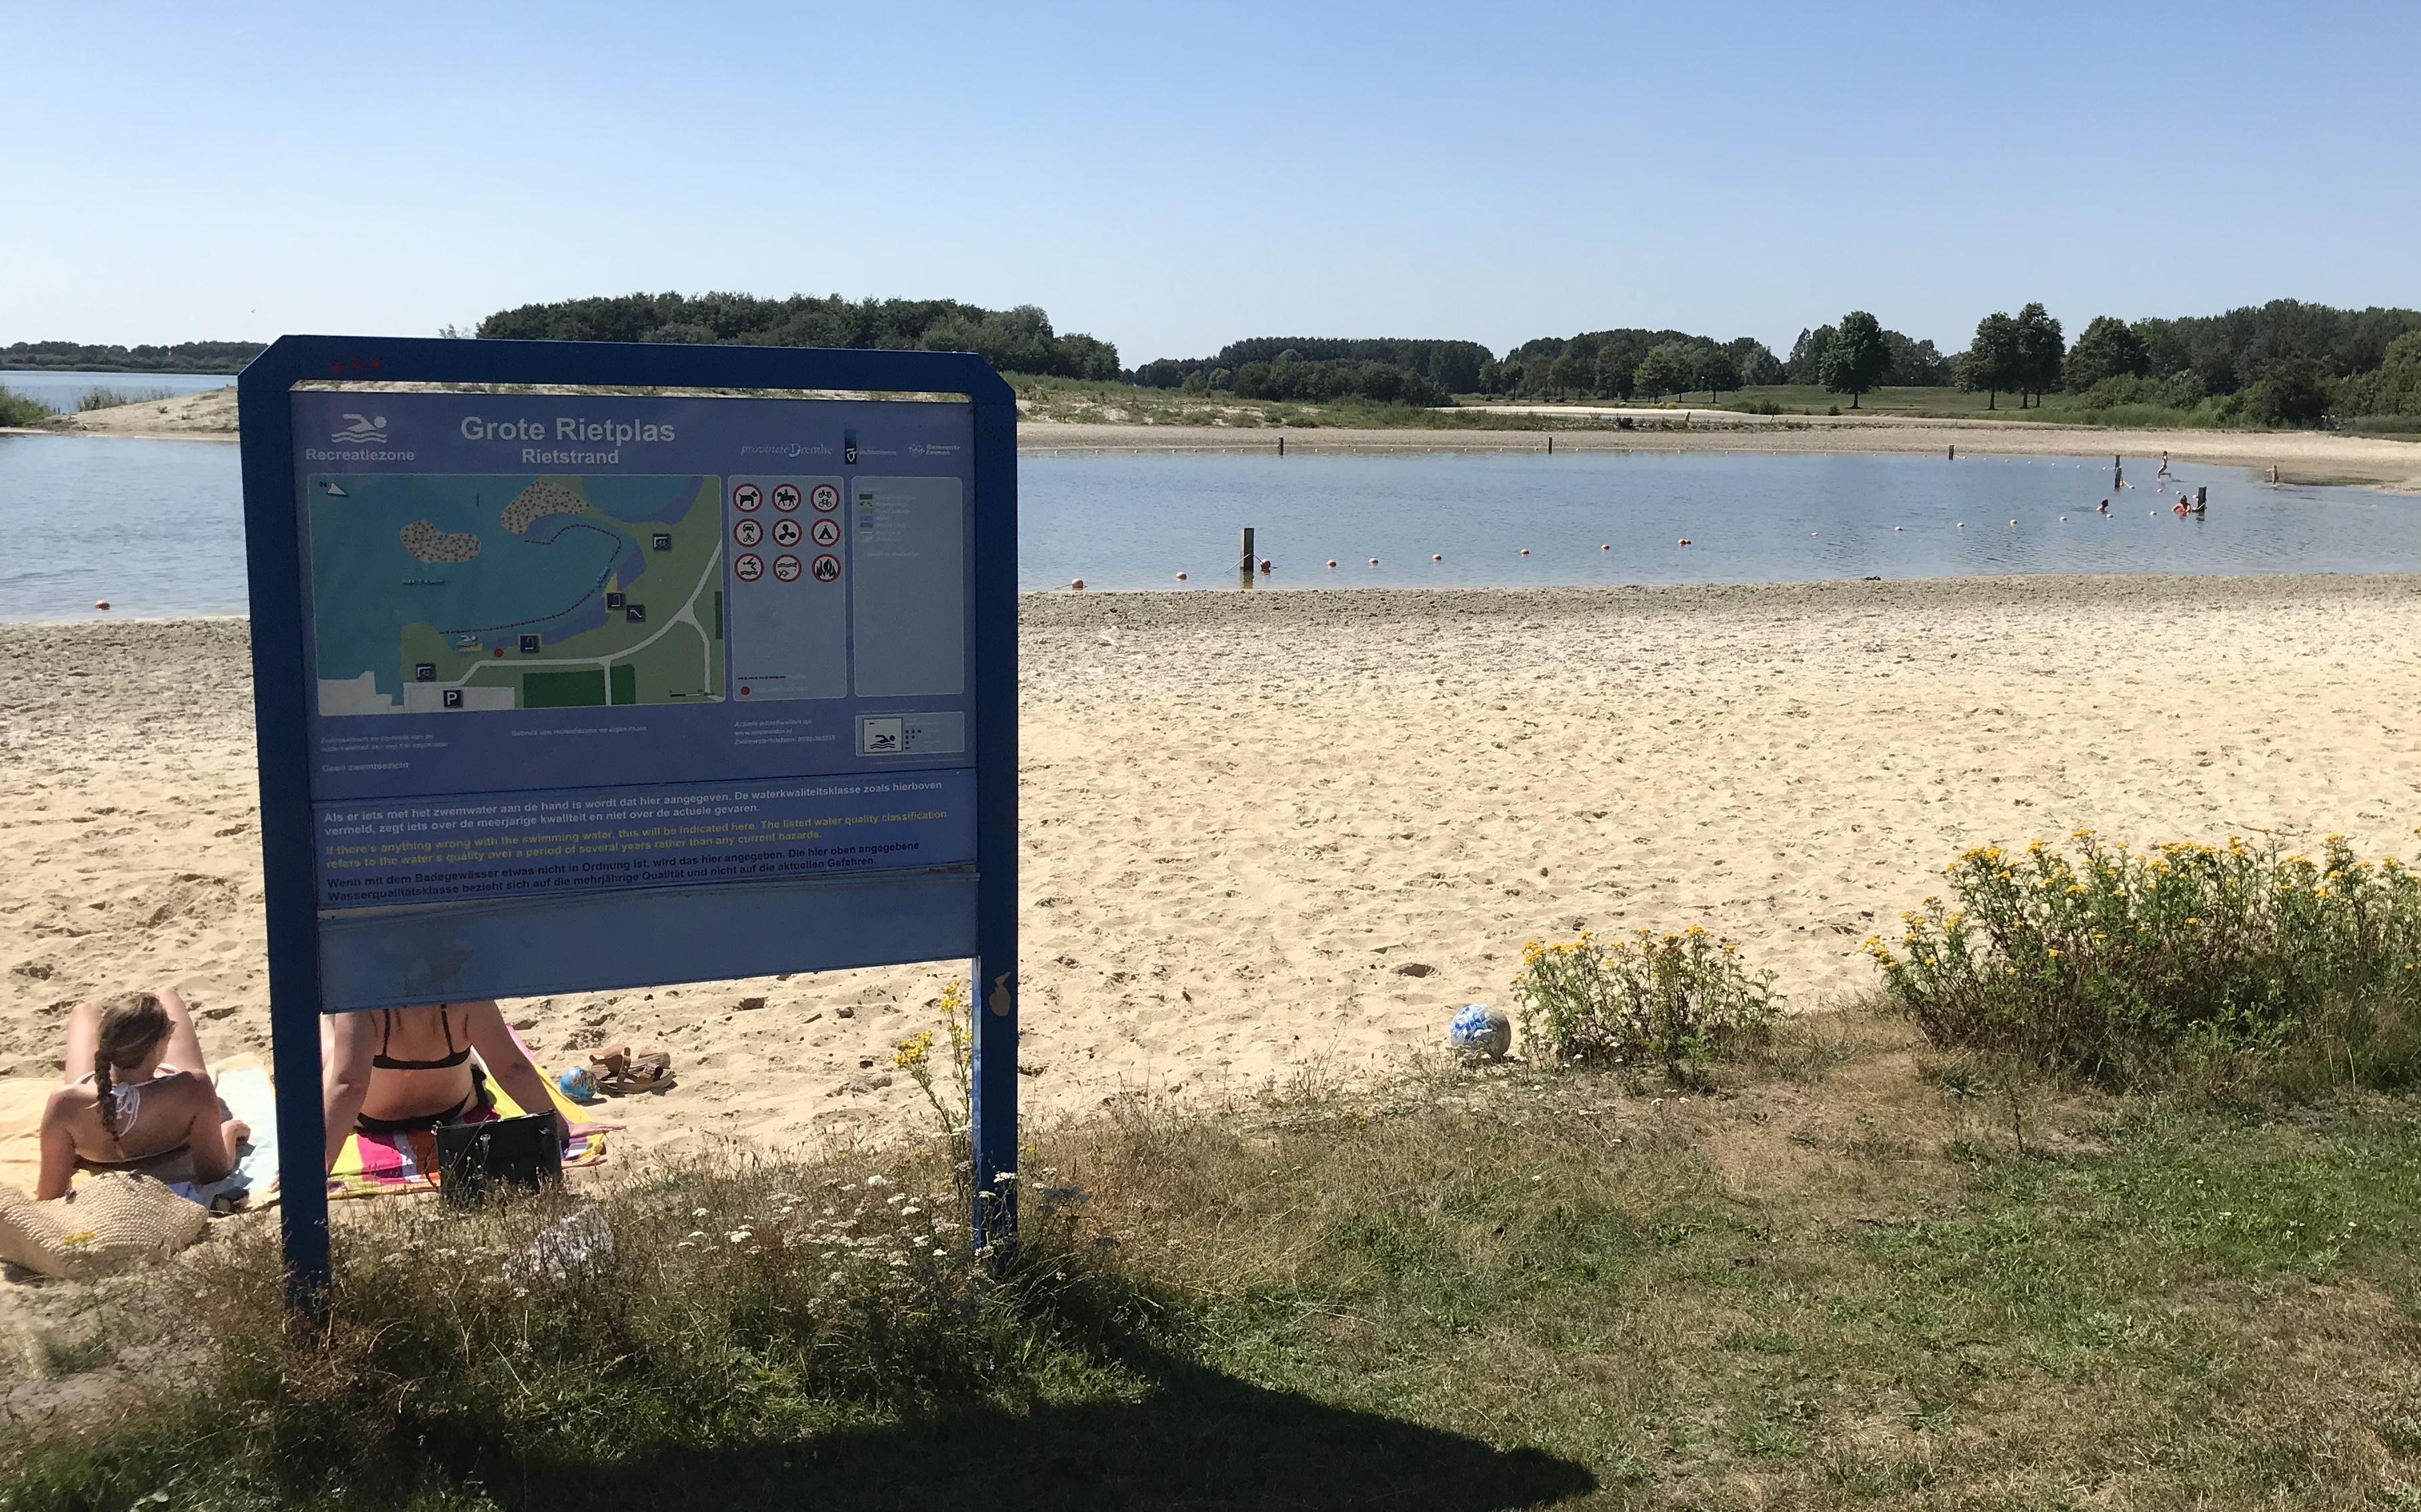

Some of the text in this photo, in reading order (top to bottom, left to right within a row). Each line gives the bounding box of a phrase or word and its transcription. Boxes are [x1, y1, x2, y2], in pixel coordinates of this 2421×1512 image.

[461, 416, 676, 446] Grote Rietplas
[306, 449, 415, 461] Recreatiezone
[522, 449, 619, 465] Rietstrand
[324, 781, 942, 822] Als er iets met het zwemwater aan de hand is wordt dat hier aangegeven. De waterkwaliteitsklasse zoals hierboven
[379, 823, 404, 834] zegt
[407, 822, 428, 831] iets
[431, 821, 456, 830] over
[461, 819, 473, 829] de
[477, 816, 537, 828] meerjarige
[540, 813, 587, 824] kwaliteit
[589, 813, 603, 821] en
[607, 811, 626, 820] niet
[629, 810, 653, 819] over
[657, 808, 670, 817] de
[673, 806, 711, 816] actuele
[715, 804, 759, 815] gevaren.
[327, 858, 361, 869] refers
[364, 858, 376, 867] to
[379, 857, 397, 865] the
[401, 854, 442, 865] waters
[447, 851, 483, 863] quality
[487, 850, 512, 859] over
[525, 847, 561, 858] period
[565, 845, 577, 854] of
[579, 842, 618, 853] several
[621, 841, 651, 852] years
[654, 839, 685, 849] rather
[689, 837, 712, 847] than
[716, 836, 735, 846] any
[738, 833, 775, 843] current
[779, 831, 822, 841] hazards.
[381, 841, 431, 853] anything
[436, 839, 471, 850] wrong
[475, 837, 497, 847] with
[501, 835, 519, 845] the
[522, 833, 579, 845] swimming
[582, 831, 615, 841] water,
[619, 829, 639, 839] this
[642, 827, 660, 837] will
[663, 827, 677, 835] be
[679, 824, 728, 834] indicated
[760, 821, 779, 829] The
[783, 818, 811, 828] listed
[814, 817, 843, 827] water
[845, 814, 879, 825] quality
[882, 811, 947, 822] classification
[327, 841, 919, 888] Wenn mit dem Badegewässer etwas nicht in Ordnung ist, wird das hier angegeben. Die hier oben angegebene
[328, 857, 876, 901] Wasserqualitätsklasse bezieht sich auf die mehrjährige Qualität und nicht auf die aktuellen Gefahren.
